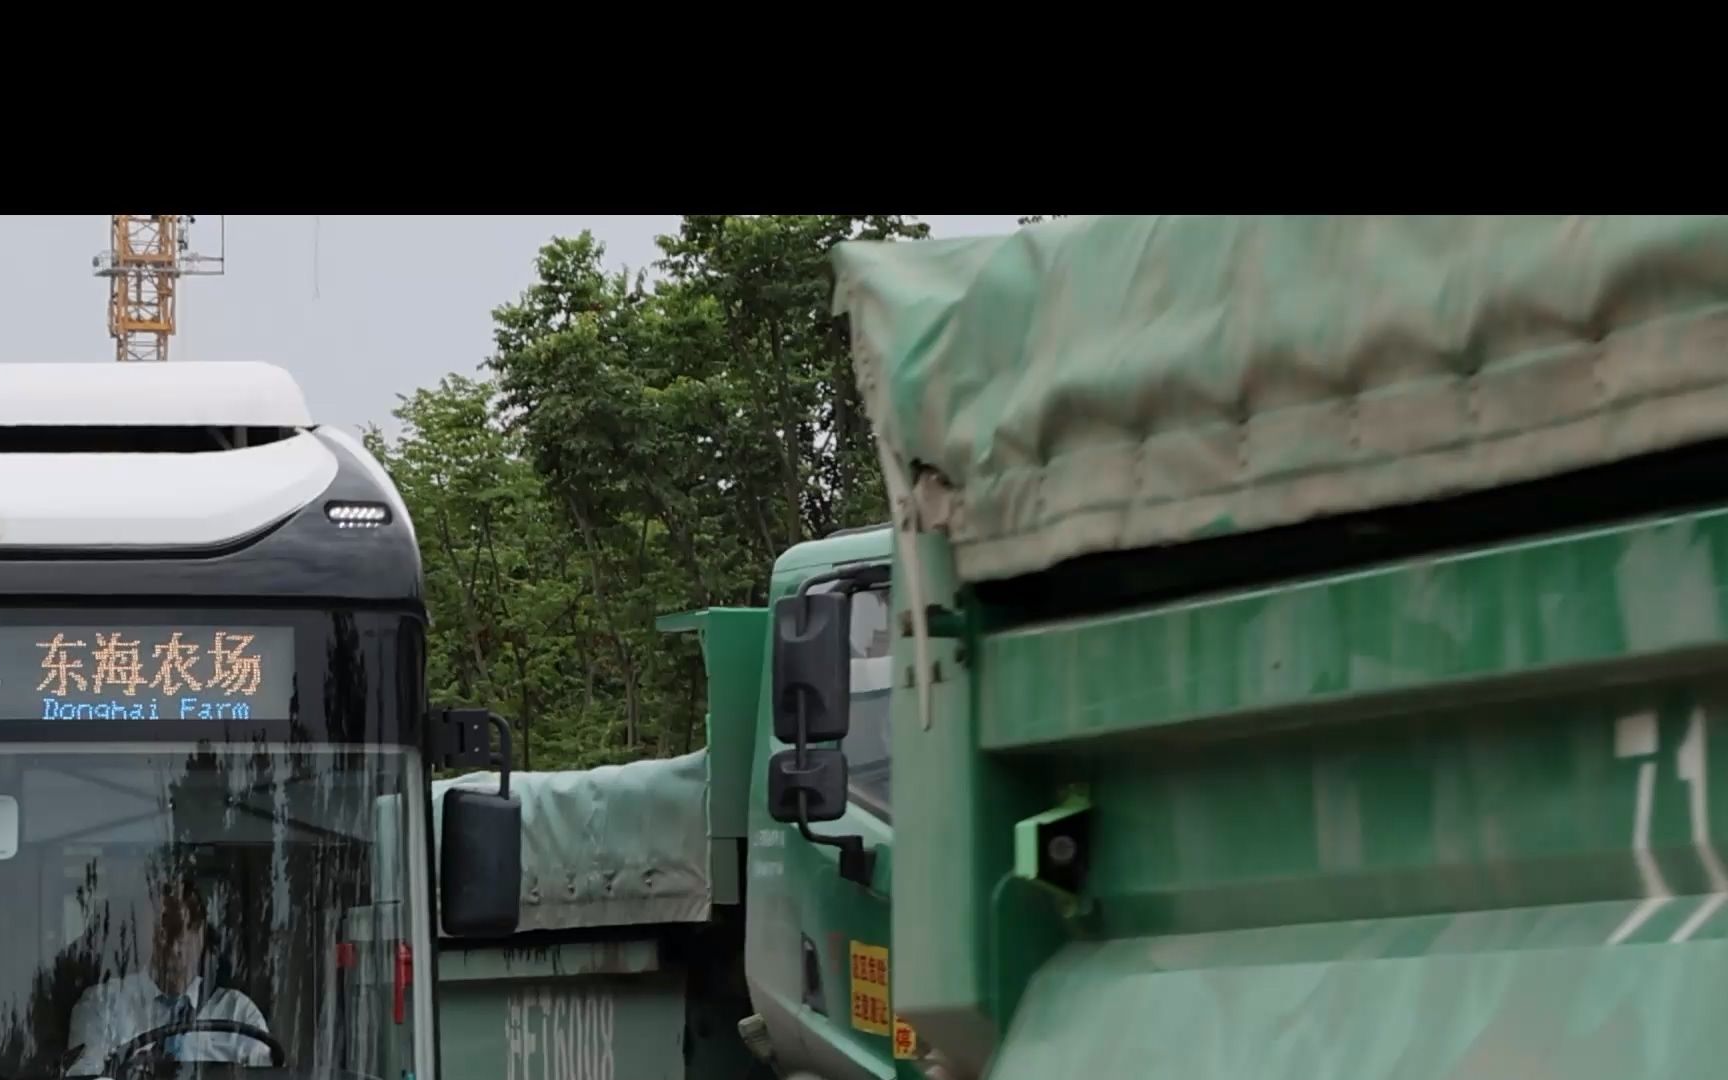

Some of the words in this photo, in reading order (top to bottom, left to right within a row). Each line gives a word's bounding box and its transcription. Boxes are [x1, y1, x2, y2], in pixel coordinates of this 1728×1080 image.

[35, 632, 262, 696] 东海农场
[42, 698, 159, 720] Donghai
[180, 698, 250, 720] Farm
